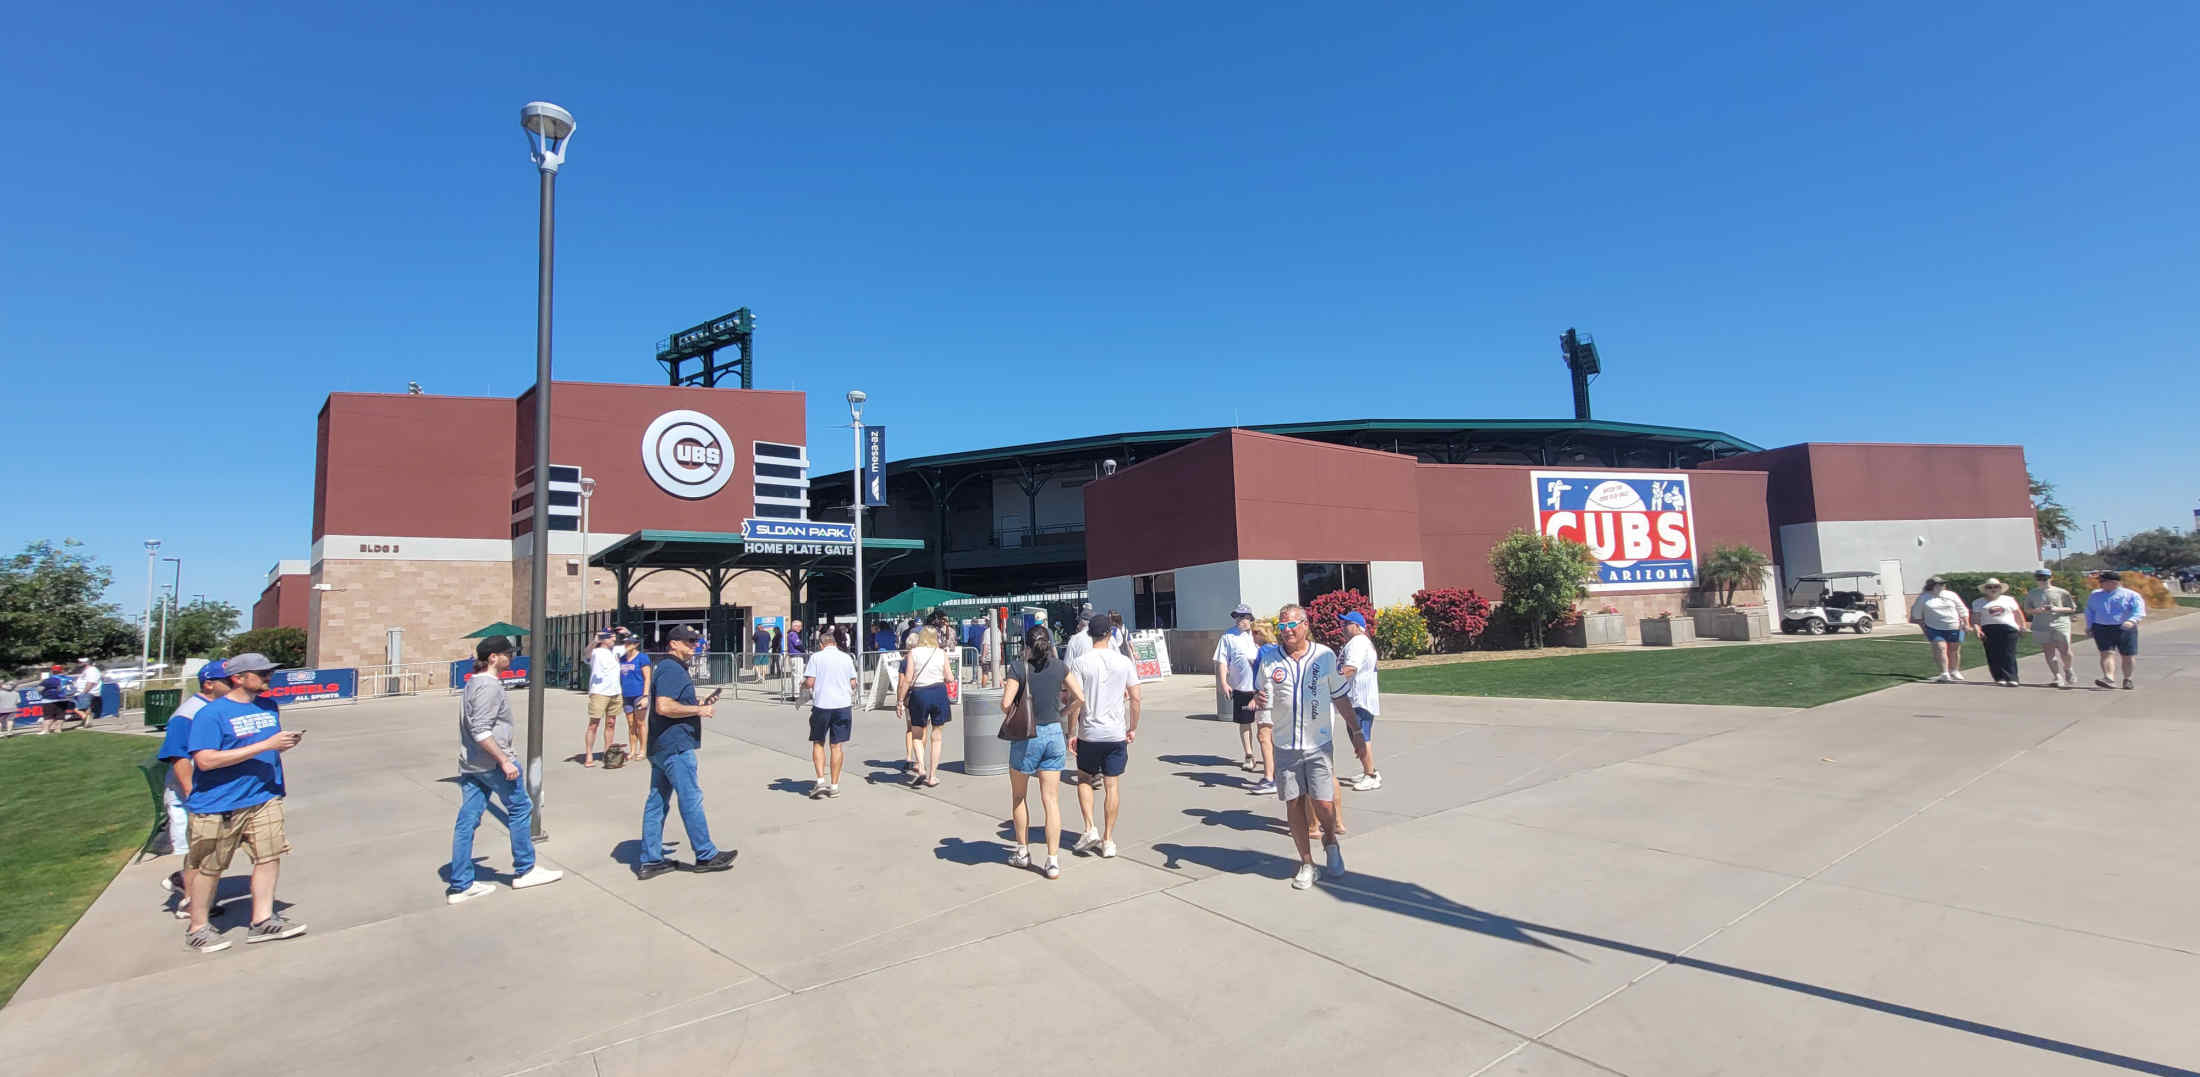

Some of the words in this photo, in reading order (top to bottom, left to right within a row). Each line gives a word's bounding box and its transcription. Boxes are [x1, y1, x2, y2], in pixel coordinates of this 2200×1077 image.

[755, 525, 806, 536] SLOAN
[1546, 511, 1687, 560] CUBS
[744, 543, 783, 553] HOME
[785, 544, 822, 554] PLATE
[825, 545, 854, 555] GATE
[1609, 568, 1691, 581] ARIZONA
[1308, 662, 1321, 697] Chicago
[311, 692, 340, 700] SPORTS
